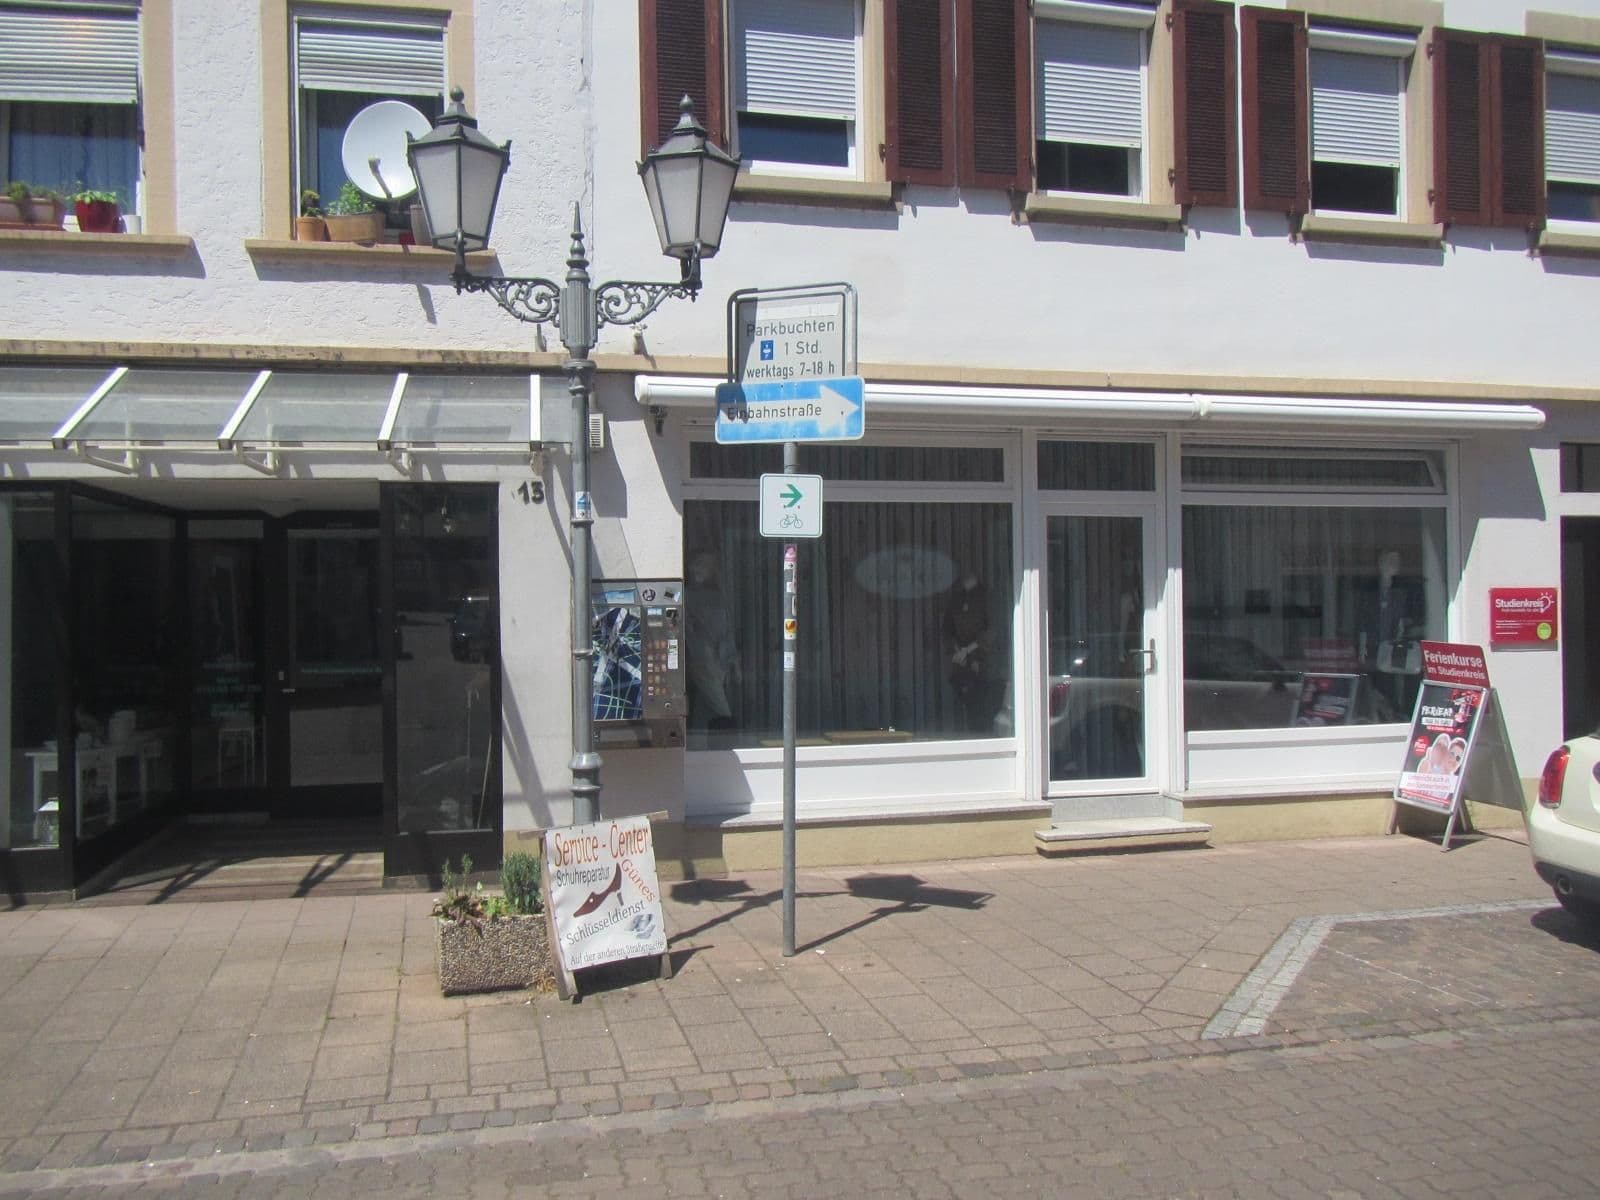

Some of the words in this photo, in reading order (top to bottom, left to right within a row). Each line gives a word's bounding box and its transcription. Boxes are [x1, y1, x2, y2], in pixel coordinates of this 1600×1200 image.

[746, 320, 835, 337] Parkbuchten
[785, 342, 789, 356] 1
[796, 340, 822, 355] Std.
[746, 364, 794, 380] werktags
[800, 361, 823, 375] 7-18
[828, 361, 835, 374] h
[517, 481, 544, 505] 13
[1495, 598, 1546, 608] Studienkreis
[1423, 650, 1483, 668] Ferienkurse
[1427, 665, 1437, 675] im
[1437, 666, 1486, 680] Studienkreis
[555, 832, 599, 867] Service
[610, 824, 649, 860] Center
[556, 867, 610, 888] Schuhreparatur
[566, 900, 646, 946] Schlüsseldienst
